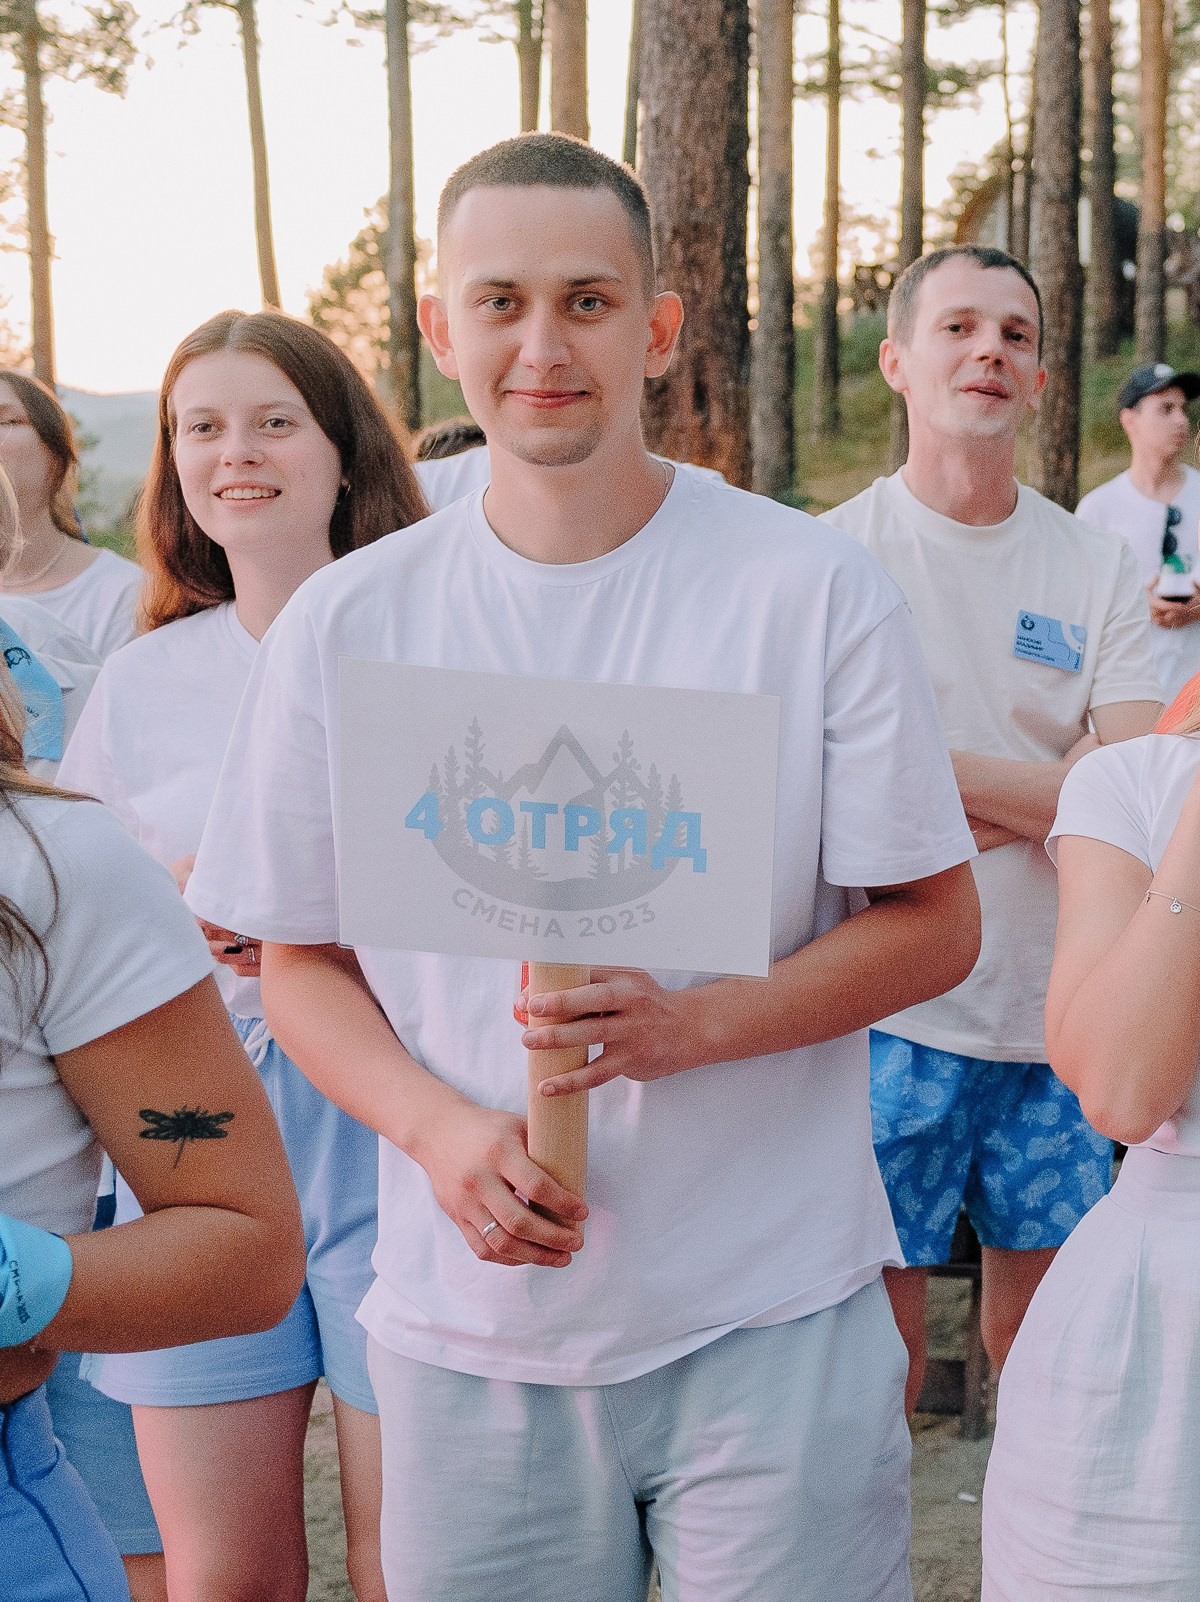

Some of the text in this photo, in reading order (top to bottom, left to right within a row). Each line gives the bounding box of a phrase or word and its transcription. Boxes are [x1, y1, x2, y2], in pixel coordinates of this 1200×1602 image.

[404, 791, 707, 874] 4 ОТРЯД
[451, 888, 656, 939] СМЕНА 2023
